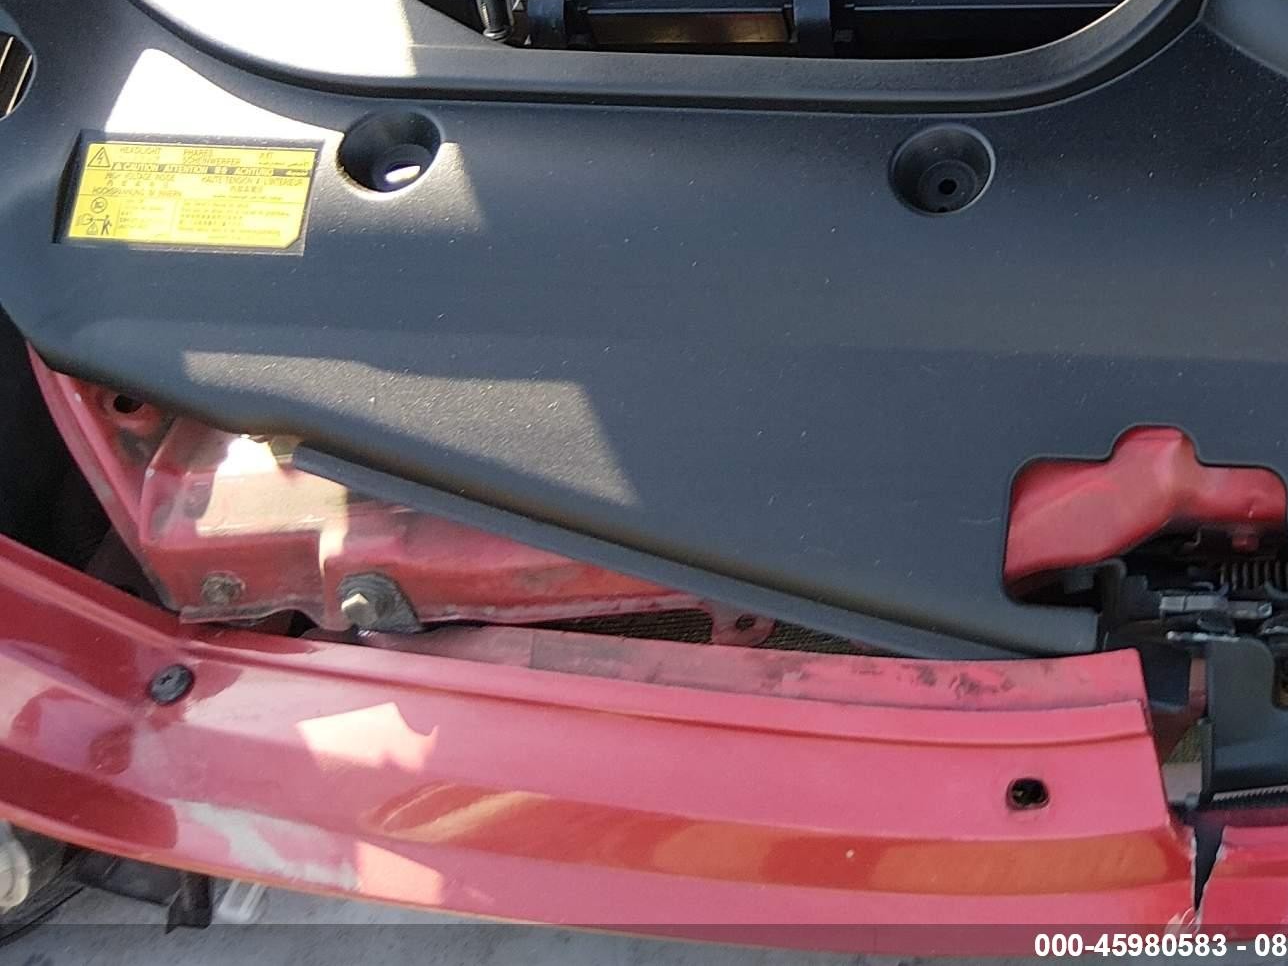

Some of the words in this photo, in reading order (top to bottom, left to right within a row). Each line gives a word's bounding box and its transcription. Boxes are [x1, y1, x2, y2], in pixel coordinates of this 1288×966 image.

[120, 147, 162, 155] HEADLIGHT
[122, 162, 159, 172] CAUTION
[163, 164, 208, 174] ATTENTION
[234, 167, 274, 176] ACHTUNG
